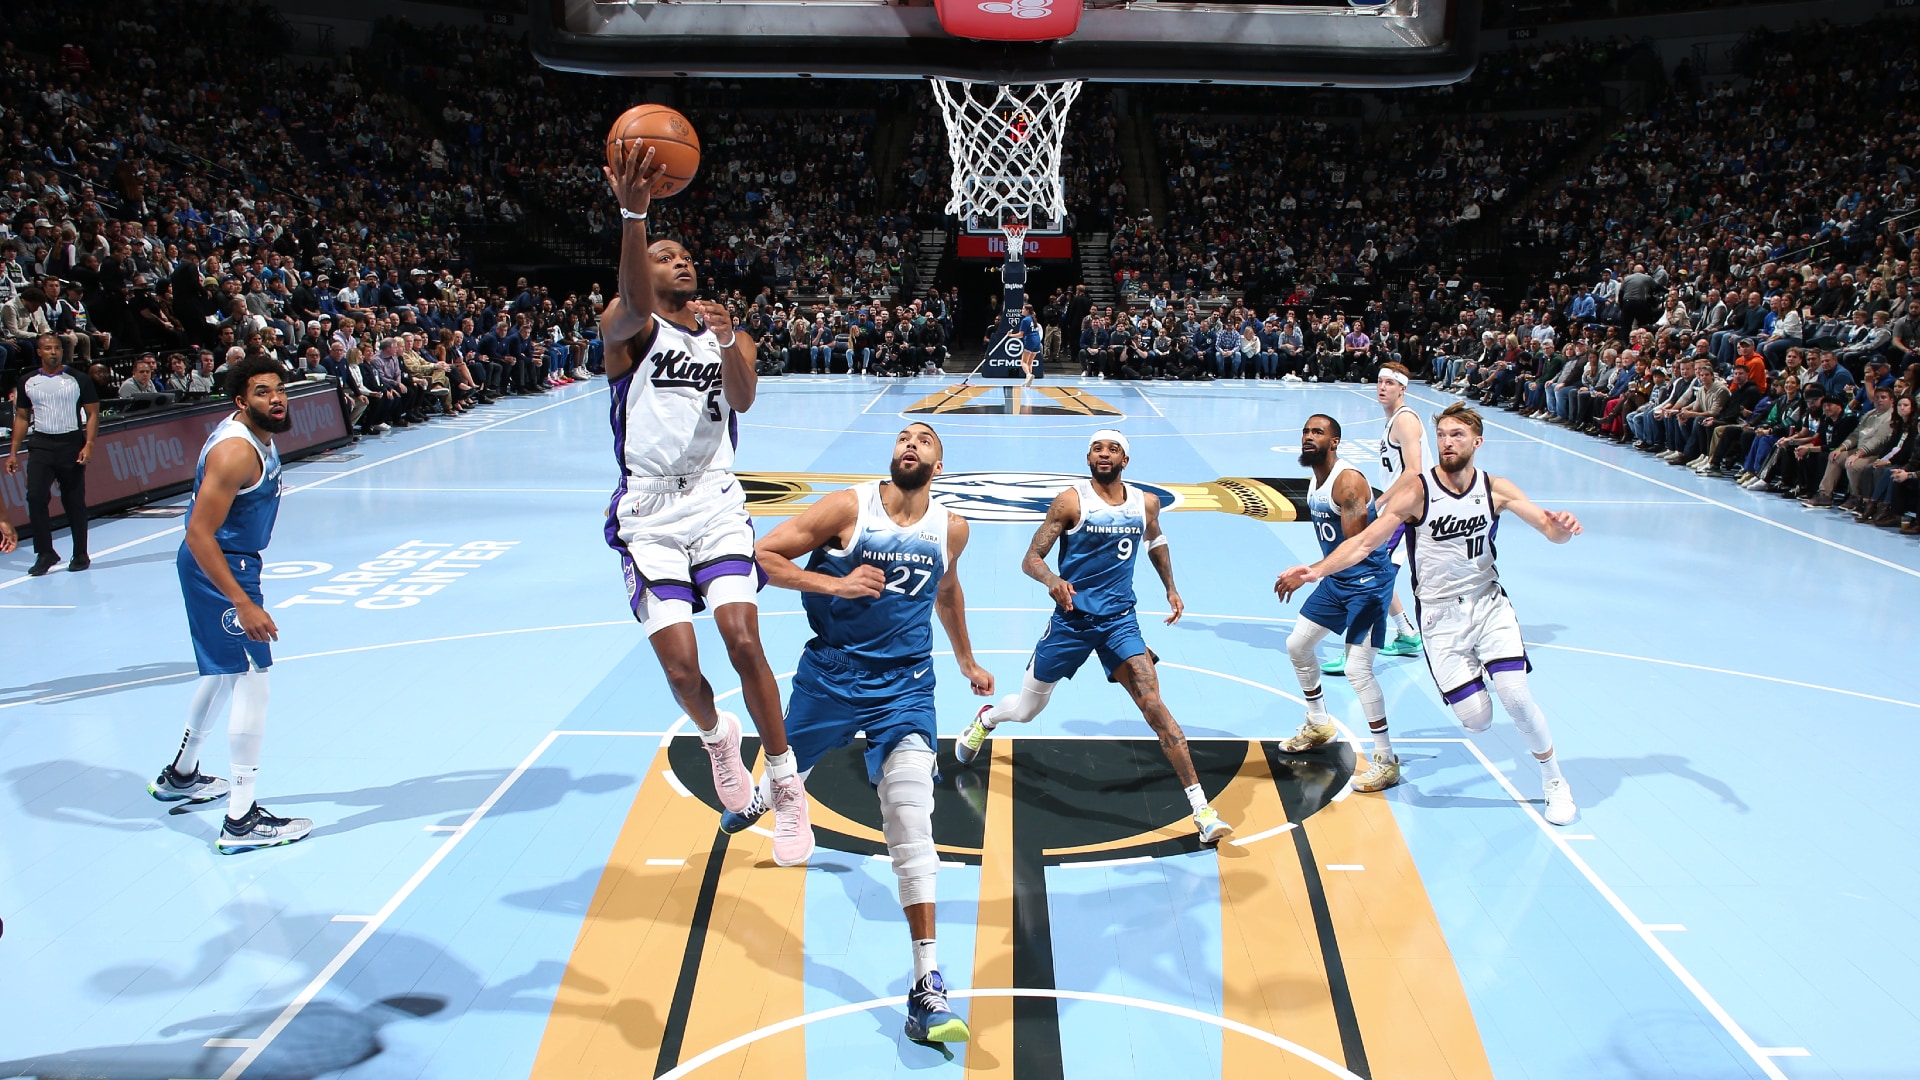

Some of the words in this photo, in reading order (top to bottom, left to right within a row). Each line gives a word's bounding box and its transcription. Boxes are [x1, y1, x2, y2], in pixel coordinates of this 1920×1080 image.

[1515, 29, 1530, 39] 104
[650, 349, 723, 392] King
[707, 389, 723, 422] 5
[105, 433, 185, 486] HyVee
[1382, 456, 1394, 473] 9
[1086, 525, 1141, 535] MINNESOTA
[1316, 520, 1337, 542] 10
[1428, 513, 1488, 542] Kings
[861, 549, 934, 566] MINNESOTA
[1116, 537, 1133, 561] 9
[1465, 534, 1485, 560] 10
[272, 539, 455, 609] TARGET
[354, 540, 521, 610] CENTER
[885, 565, 932, 597] 27
